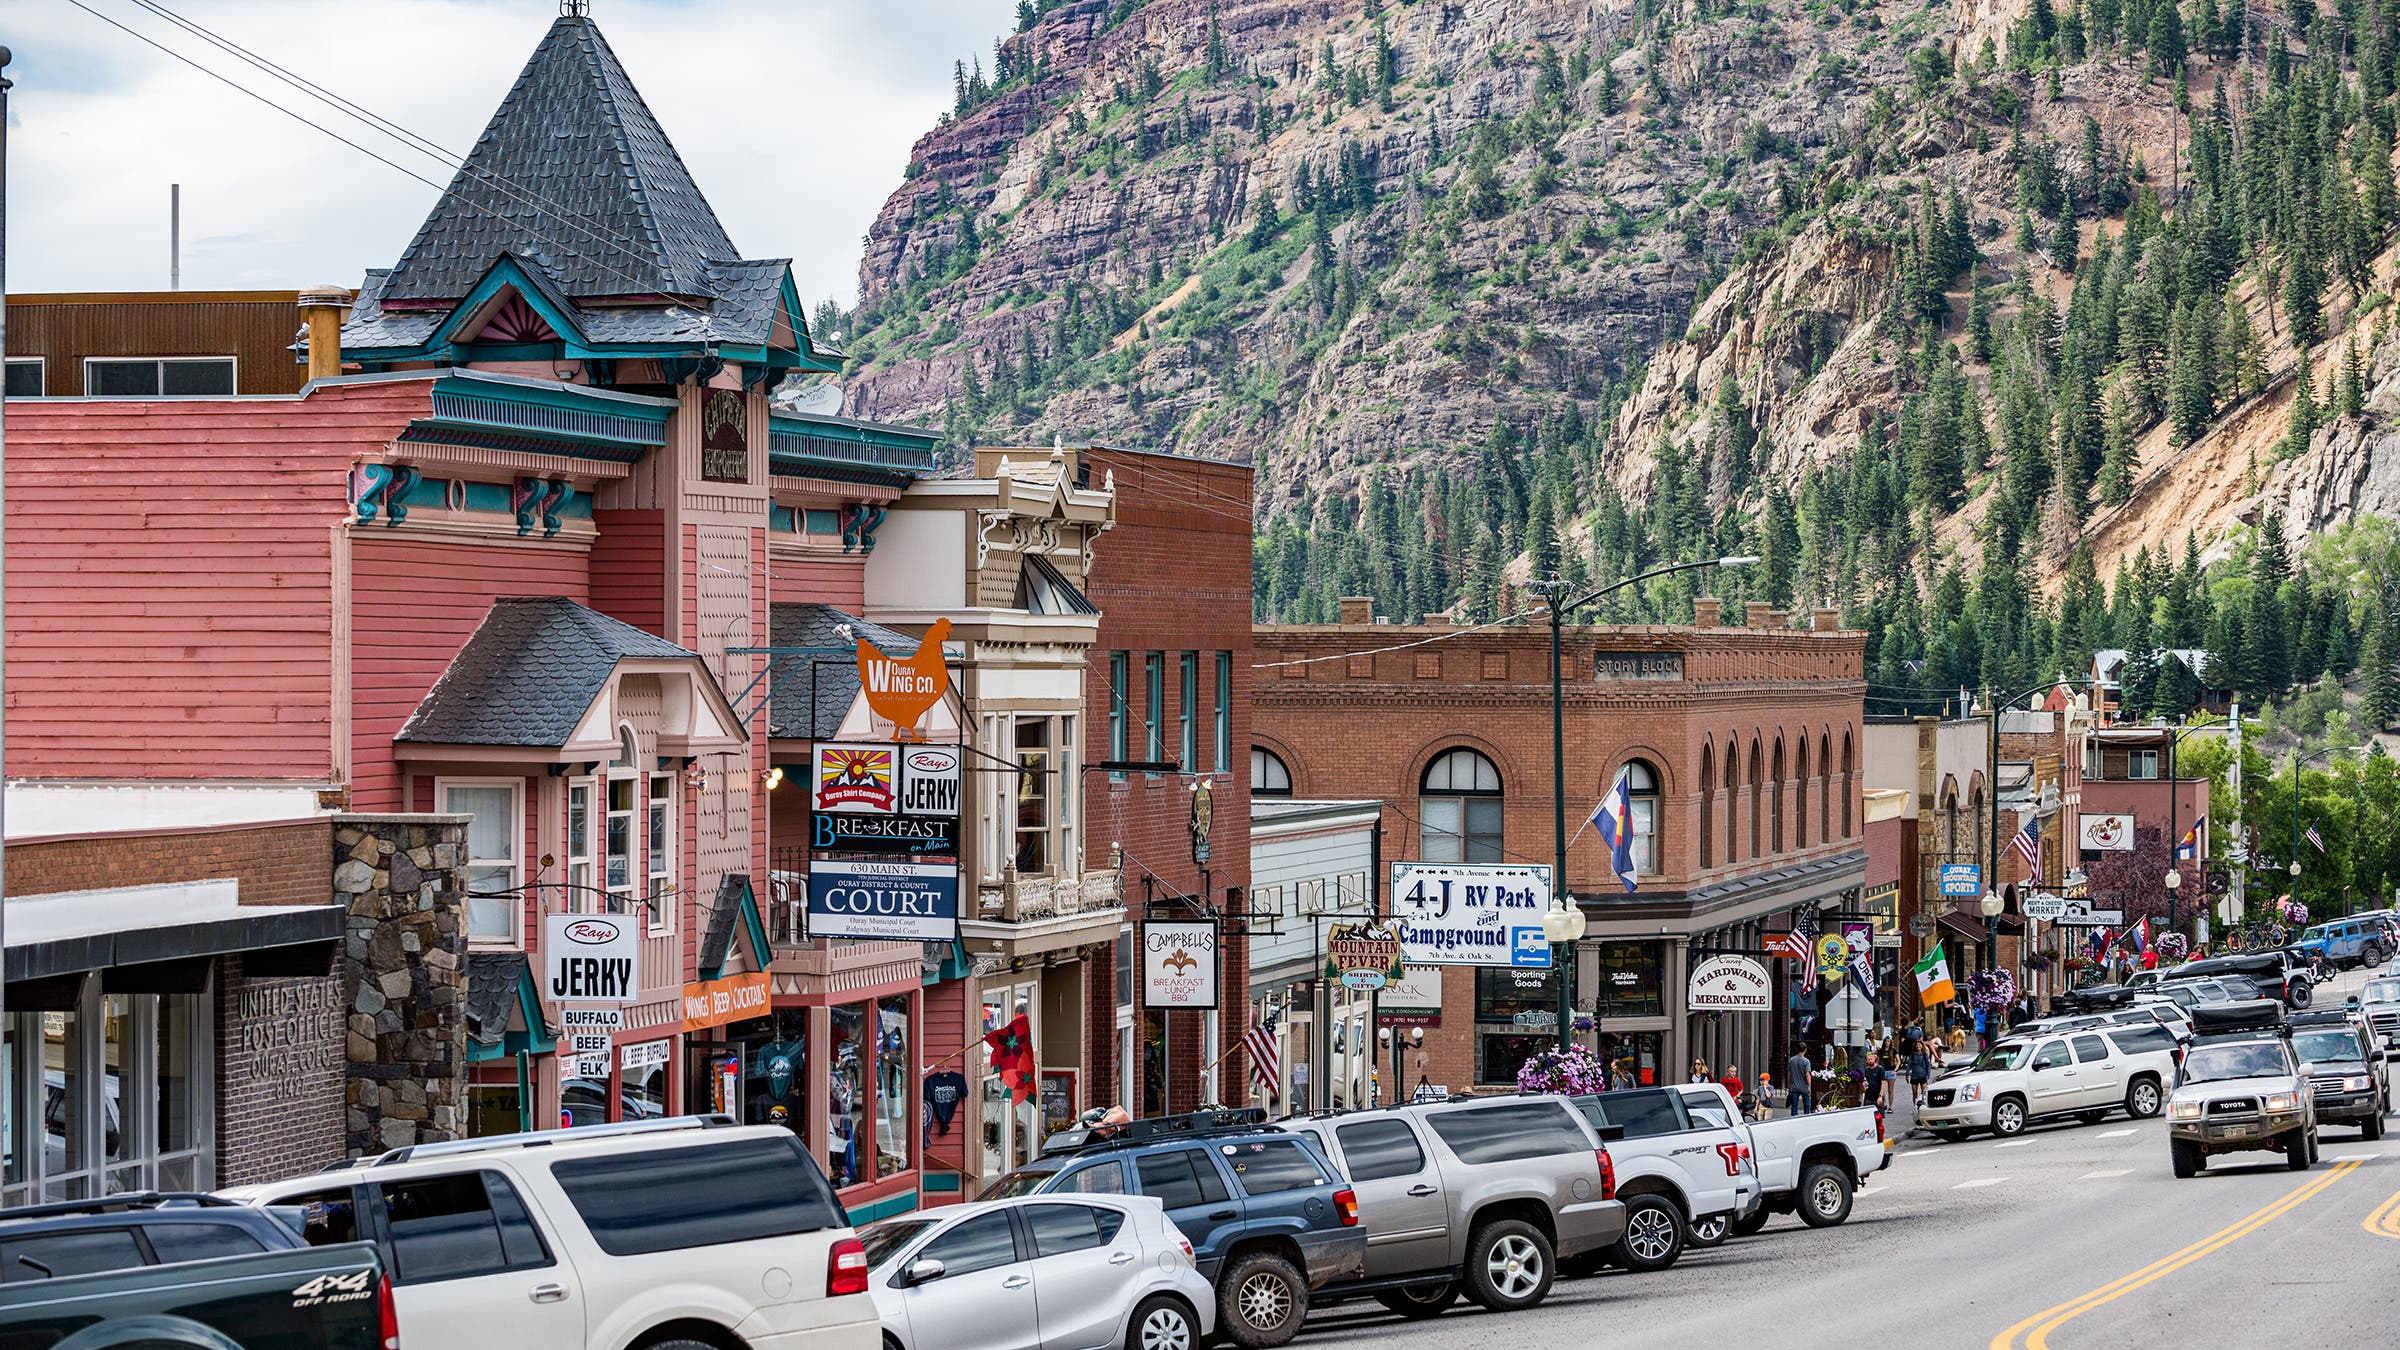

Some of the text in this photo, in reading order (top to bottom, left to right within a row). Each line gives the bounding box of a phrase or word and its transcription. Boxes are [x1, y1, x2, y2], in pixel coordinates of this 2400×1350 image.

[704, 389, 746, 442] CHIPETA
[1598, 660, 1680, 672] STORY BLOCK
[867, 660, 937, 694] WING CO.
[915, 755, 949, 769] Rays
[843, 788, 858, 797] Shirt
[858, 789, 887, 801] Company
[905, 777, 958, 810] JERKY
[814, 814, 949, 847] BREKFAST
[924, 840, 950, 852] Main
[850, 864, 917, 875] 630 MAIN ST.
[1466, 869, 1490, 877] Avenue
[900, 882, 930, 890] COUNTY
[1945, 882, 1975, 893] SPORTS
[825, 888, 942, 915] COURT
[1404, 879, 1536, 919] 4-J RV Park
[2029, 906, 2061, 914] MARKET
[849, 917, 916, 926] Ouray Municipal Court
[1476, 911, 1500, 926] and
[2094, 915, 2116, 923] Ouray
[574, 924, 613, 941] Rays
[845, 925, 920, 935] Ridgway Municipal Court
[1399, 924, 1507, 950] Campground
[1329, 940, 1399, 954] MOUNTAIN
[1337, 955, 1390, 971] FEVER
[1442, 952, 1456, 960] Ave.
[1467, 952, 1482, 960] Oak
[552, 957, 632, 997] JERKY
[1153, 978, 1205, 986] BREAKFAST
[1511, 970, 1546, 980] Sporting
[1696, 967, 1765, 988] HARDWARE
[1858, 961, 1875, 990] OPEN
[1164, 986, 1195, 994] LUNCH
[1514, 979, 1542, 988] Goods
[1724, 979, 1737, 991] &
[239, 980, 342, 1020] UNITED STATES
[685, 983, 767, 1020] WINGS BEER COCKTAILS
[1171, 994, 1188, 1002] BBQ
[1695, 994, 1766, 1005] MERCANTILE
[565, 1011, 618, 1025] BUFFALO
[242, 1012, 337, 1053] POST OFFICE
[576, 1036, 606, 1050] BEEF
[630, 1046, 643, 1065] BEEF
[646, 1041, 669, 1062] BUFFALO
[580, 1062, 604, 1076] ELK
[2220, 1101, 2246, 1109] TOYOTA
[1668, 1145, 1710, 1157] SPORT
[292, 1290, 372, 1308] OFF ROAD
